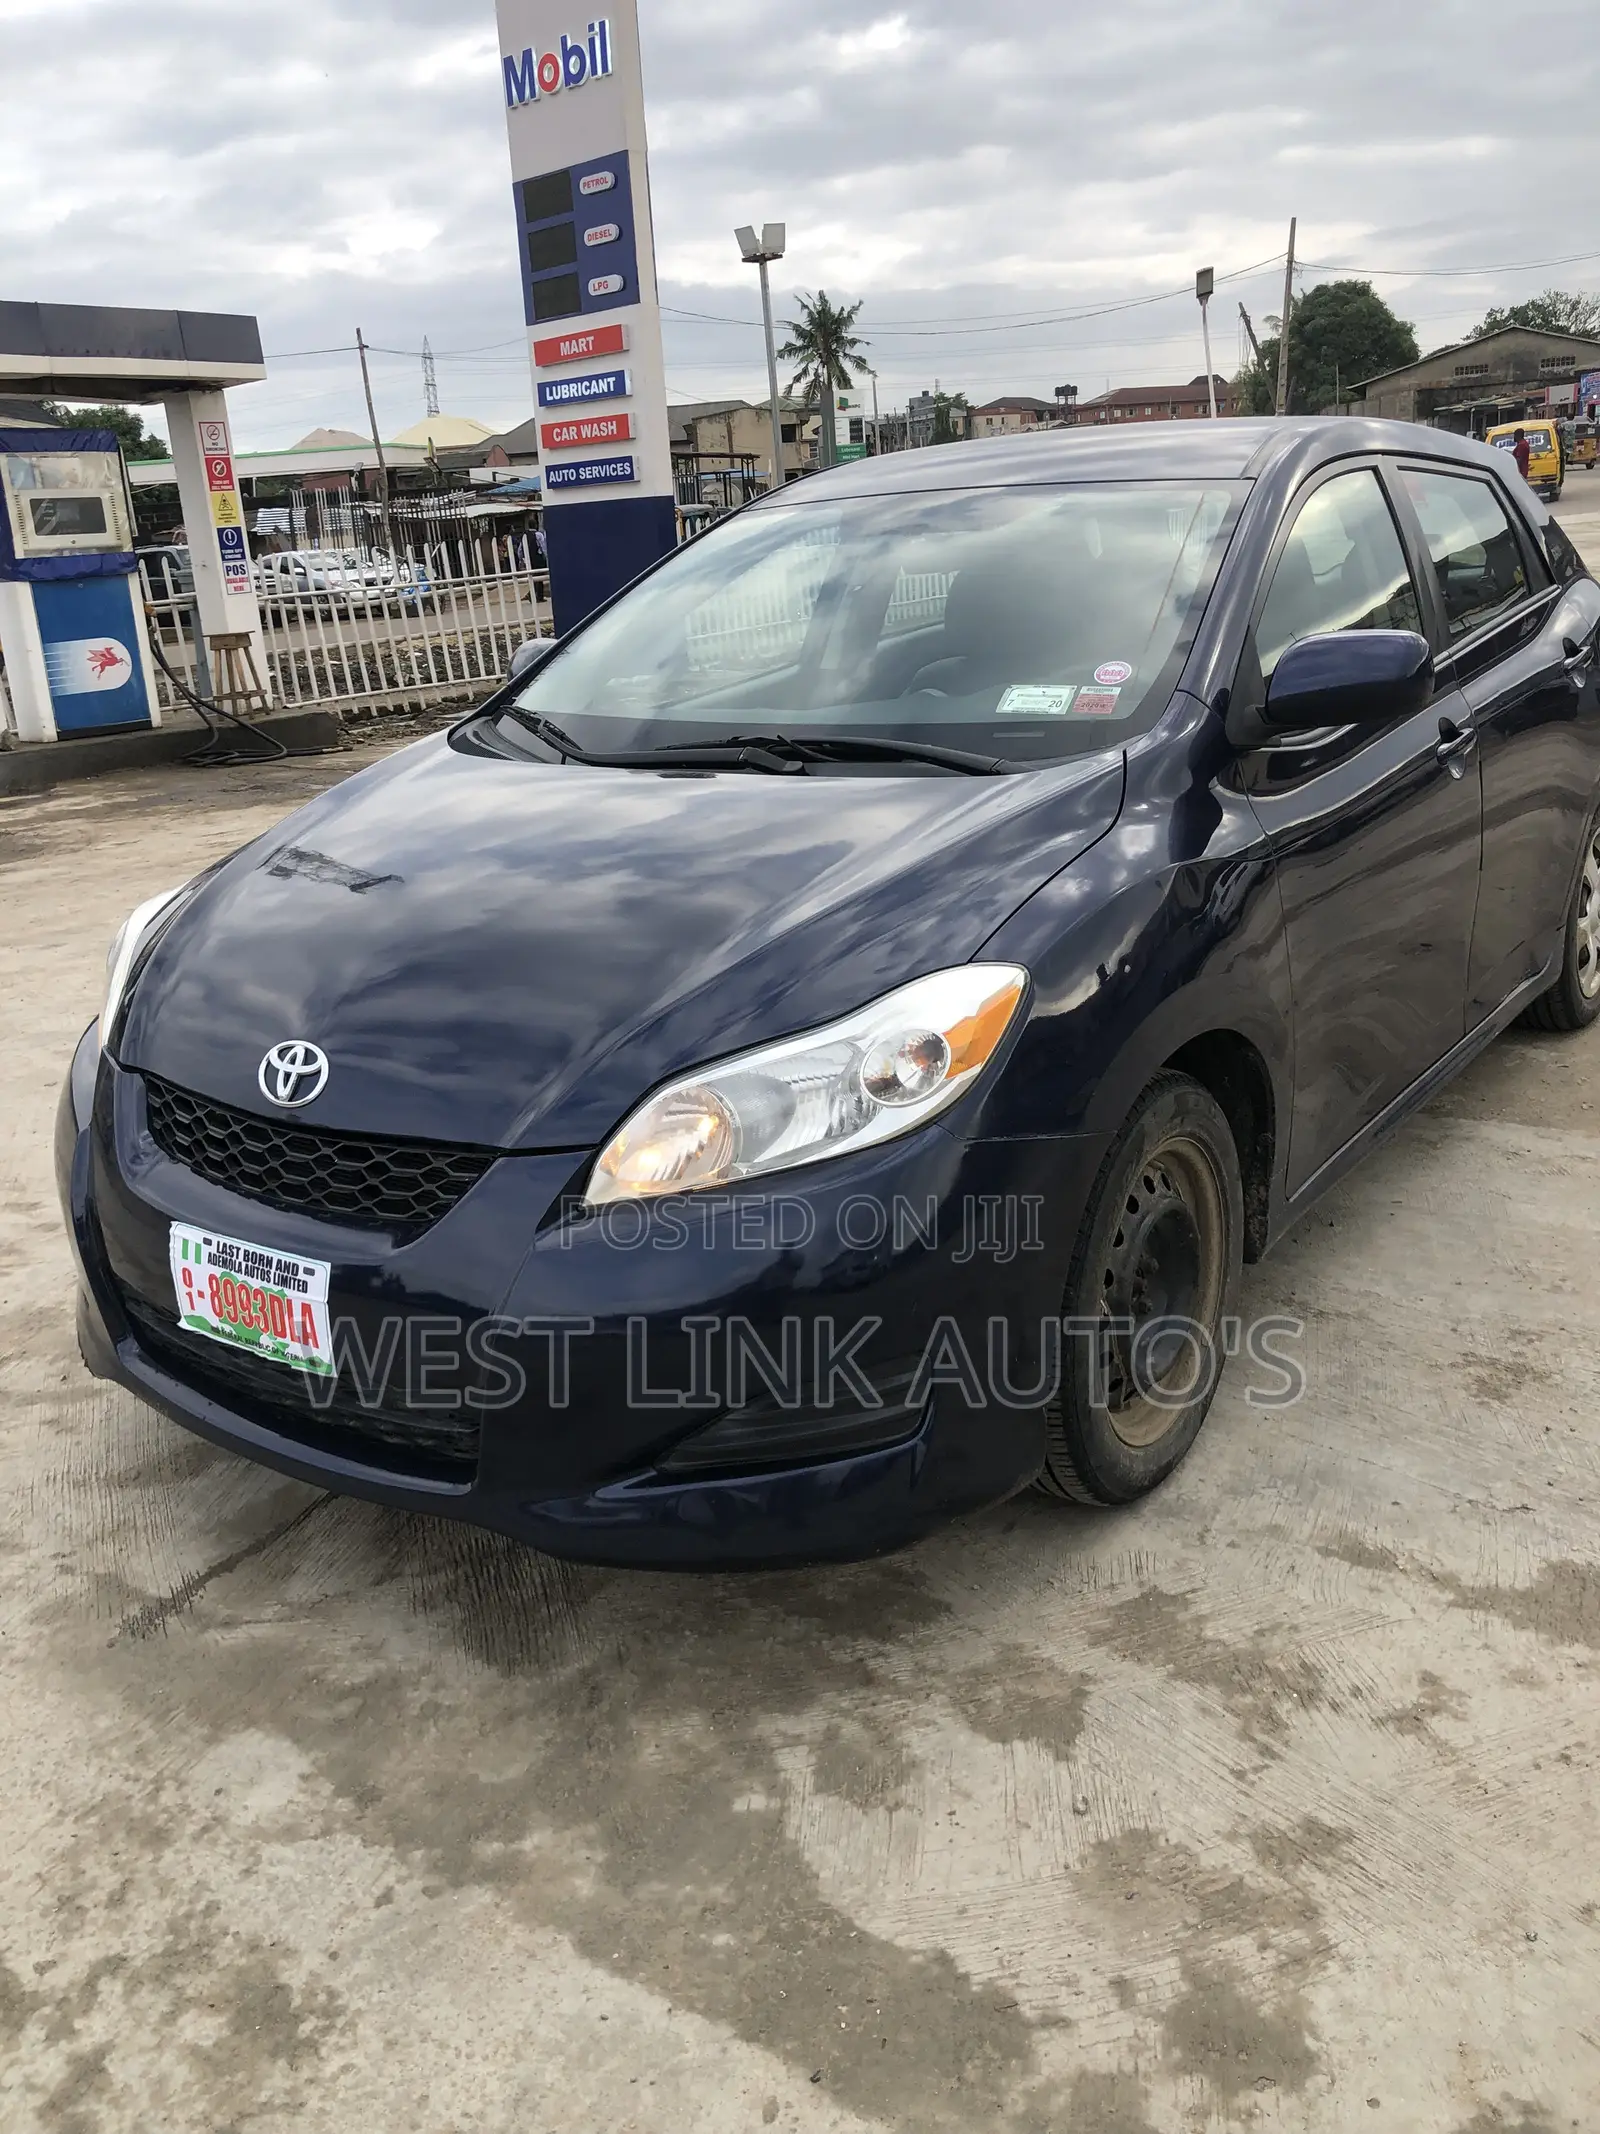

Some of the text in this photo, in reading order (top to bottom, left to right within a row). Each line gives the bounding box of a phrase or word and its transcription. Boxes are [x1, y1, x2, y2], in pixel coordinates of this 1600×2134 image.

[502, 19, 612, 108] Mobil
[582, 176, 609, 190] PETROL
[587, 228, 613, 243] DIESEL
[592, 280, 609, 292] LPG
[560, 336, 595, 357] MART
[545, 377, 616, 401] LUBRICANT
[553, 420, 617, 442] CAR WASH
[549, 462, 631, 483] AUTO SERVICES
[225, 564, 247, 577] POS
[1047, 700, 1063, 708] 20
[216, 1240, 300, 1277] LAST BORN AND
[207, 1252, 309, 1294] ADEMOLA AUTOS LIMITED
